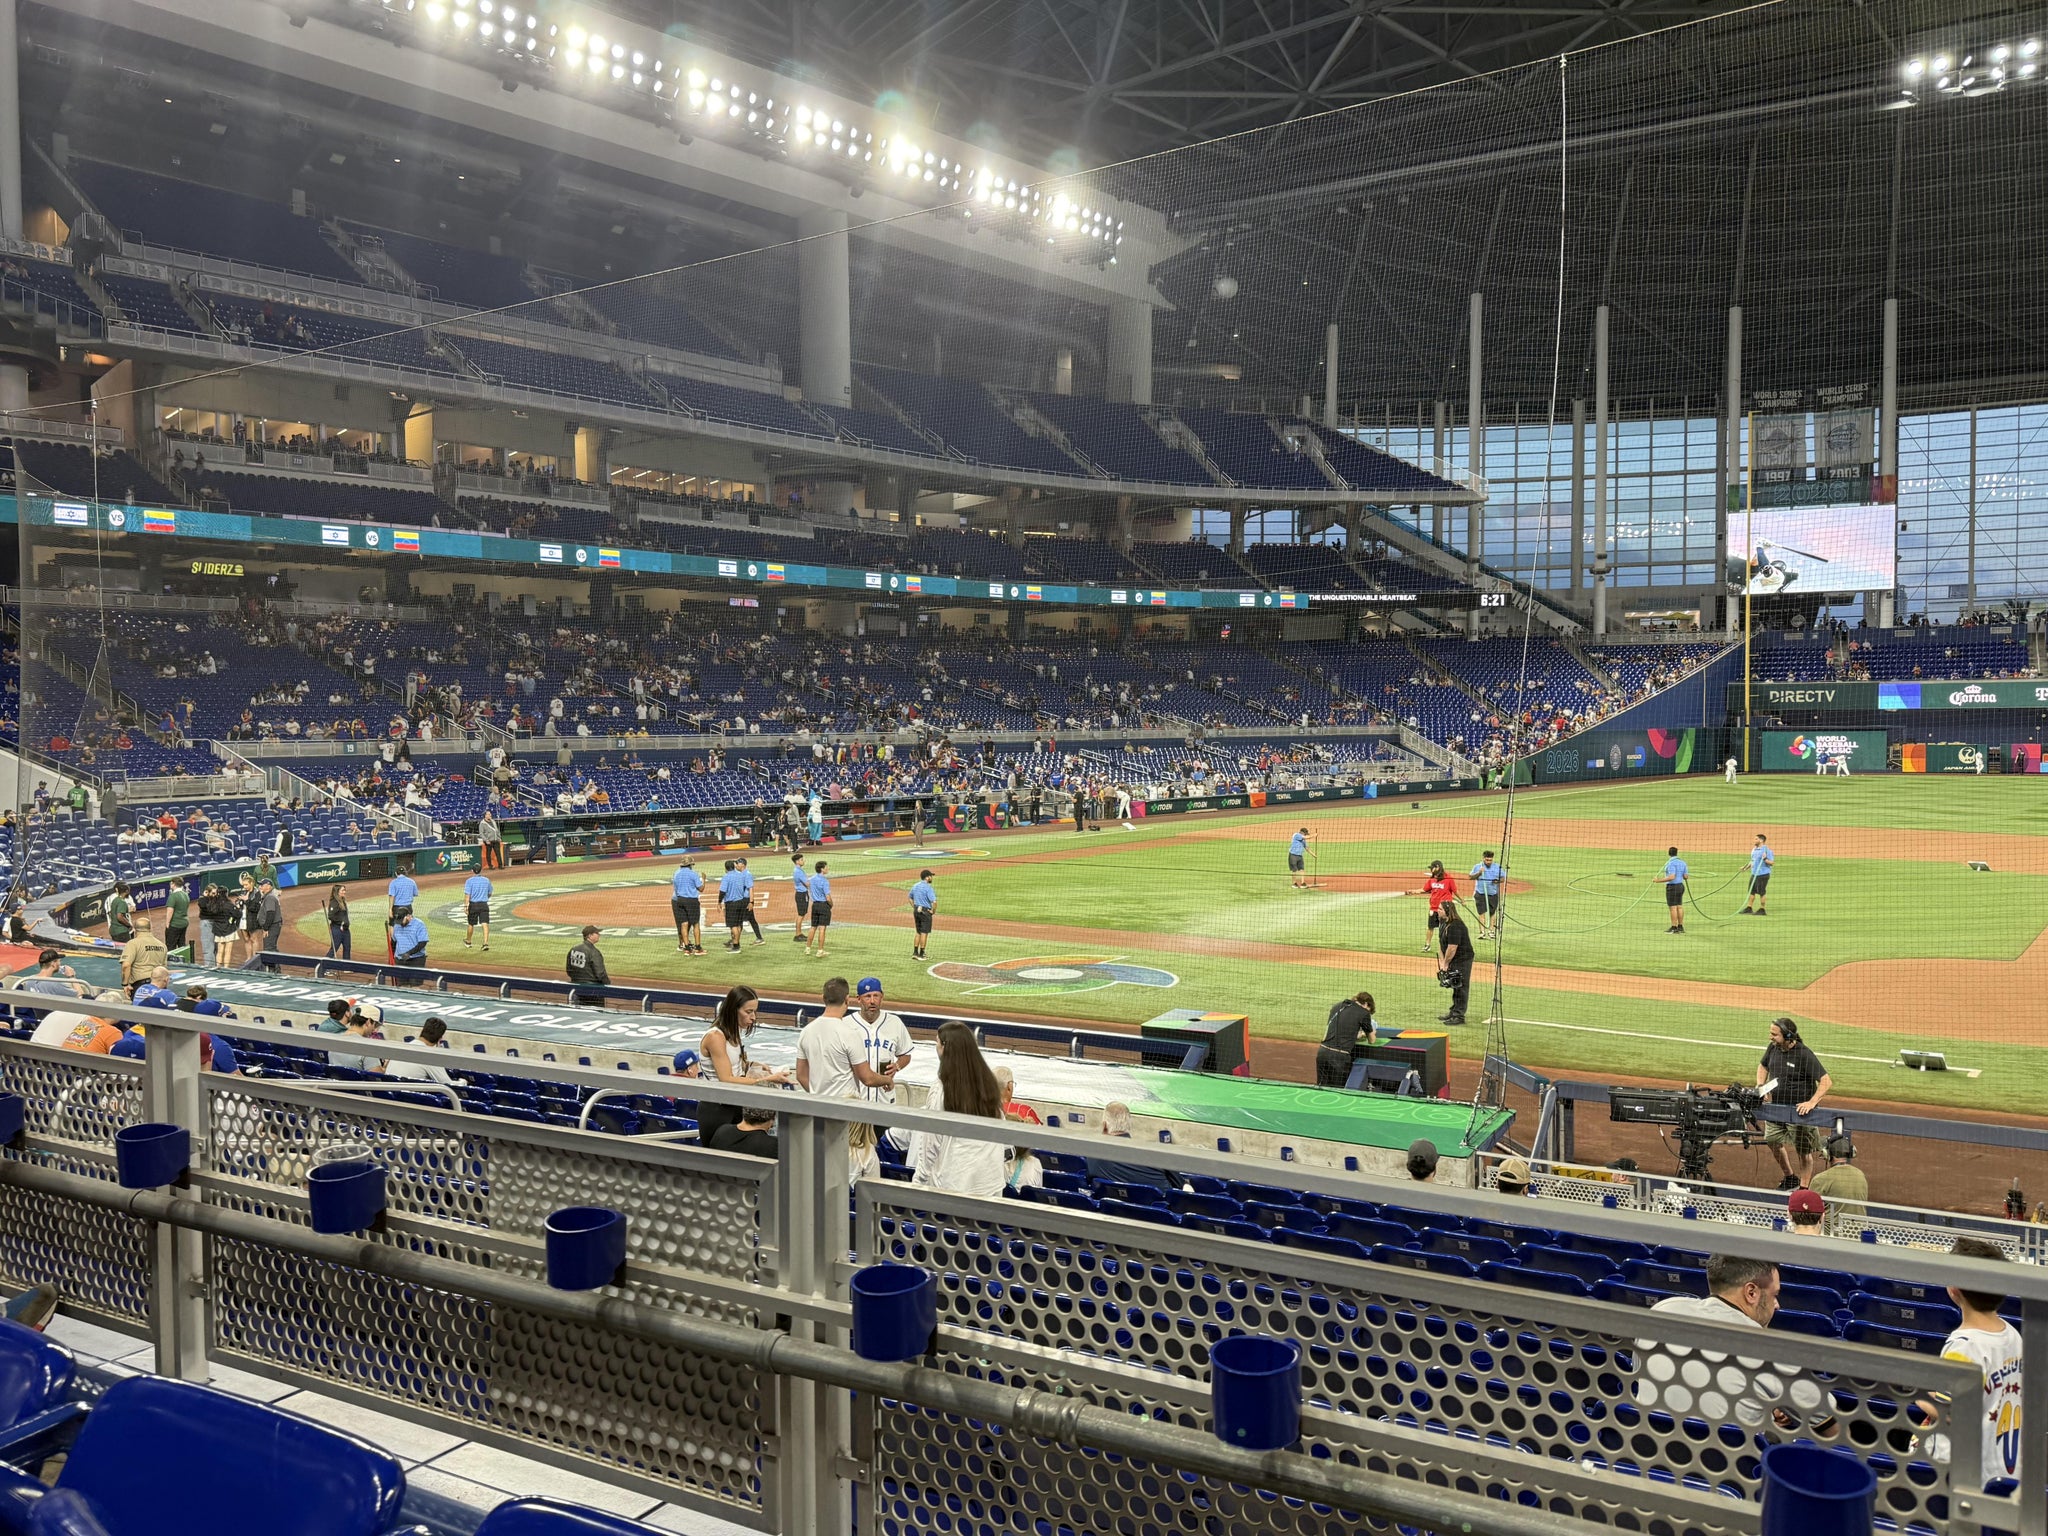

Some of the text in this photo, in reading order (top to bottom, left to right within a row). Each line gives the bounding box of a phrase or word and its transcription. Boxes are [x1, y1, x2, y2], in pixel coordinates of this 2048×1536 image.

[1753, 389, 1803, 399] WORLD SERIES
[1817, 382, 1869, 396] WORLD SERIES
[1758, 398, 1798, 408] CHAMPIONS
[1823, 393, 1864, 405] CHAMPIONS
[1765, 470, 1792, 482] 1997
[1829, 467, 1860, 478] 2003
[1774, 480, 1848, 505] 2026
[1481, 594, 1505, 606] 6:21
[1769, 690, 1836, 703] DIRECTV
[1949, 691, 1997, 706] Corona
[347, 744, 354, 752] 19
[1547, 750, 1579, 773] 2026
[173, 975, 702, 1043] WORLD BASEBALL CLASSIC
[864, 1038, 894, 1052] RAEL
[1235, 1083, 1471, 1124] 2026
